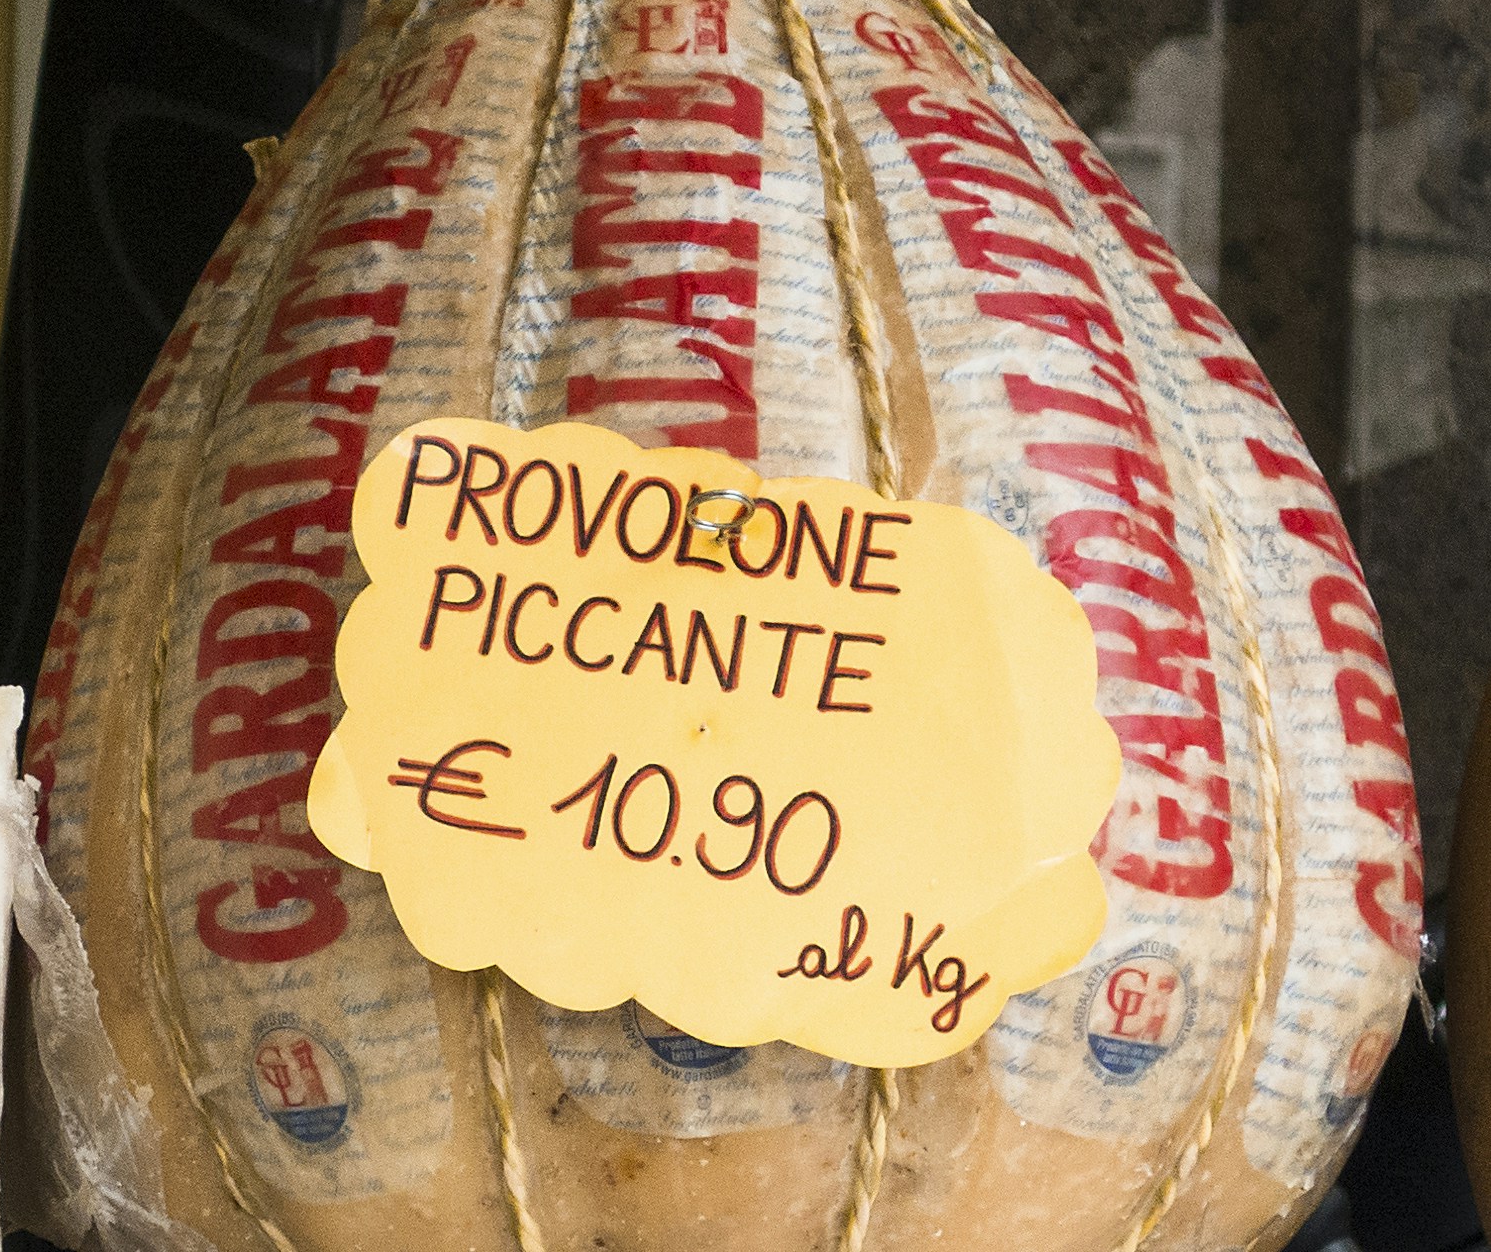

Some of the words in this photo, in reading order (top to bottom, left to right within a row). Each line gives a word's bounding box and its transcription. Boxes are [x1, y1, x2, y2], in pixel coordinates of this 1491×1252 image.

[395, 435, 912, 595] PROVOLONE
[420, 566, 885, 713] PICCANTE
[387, 739, 527, 840] €
[551, 753, 841, 895] 10.90
[777, 904, 873, 981] al
[891, 912, 989, 1033] Kg
